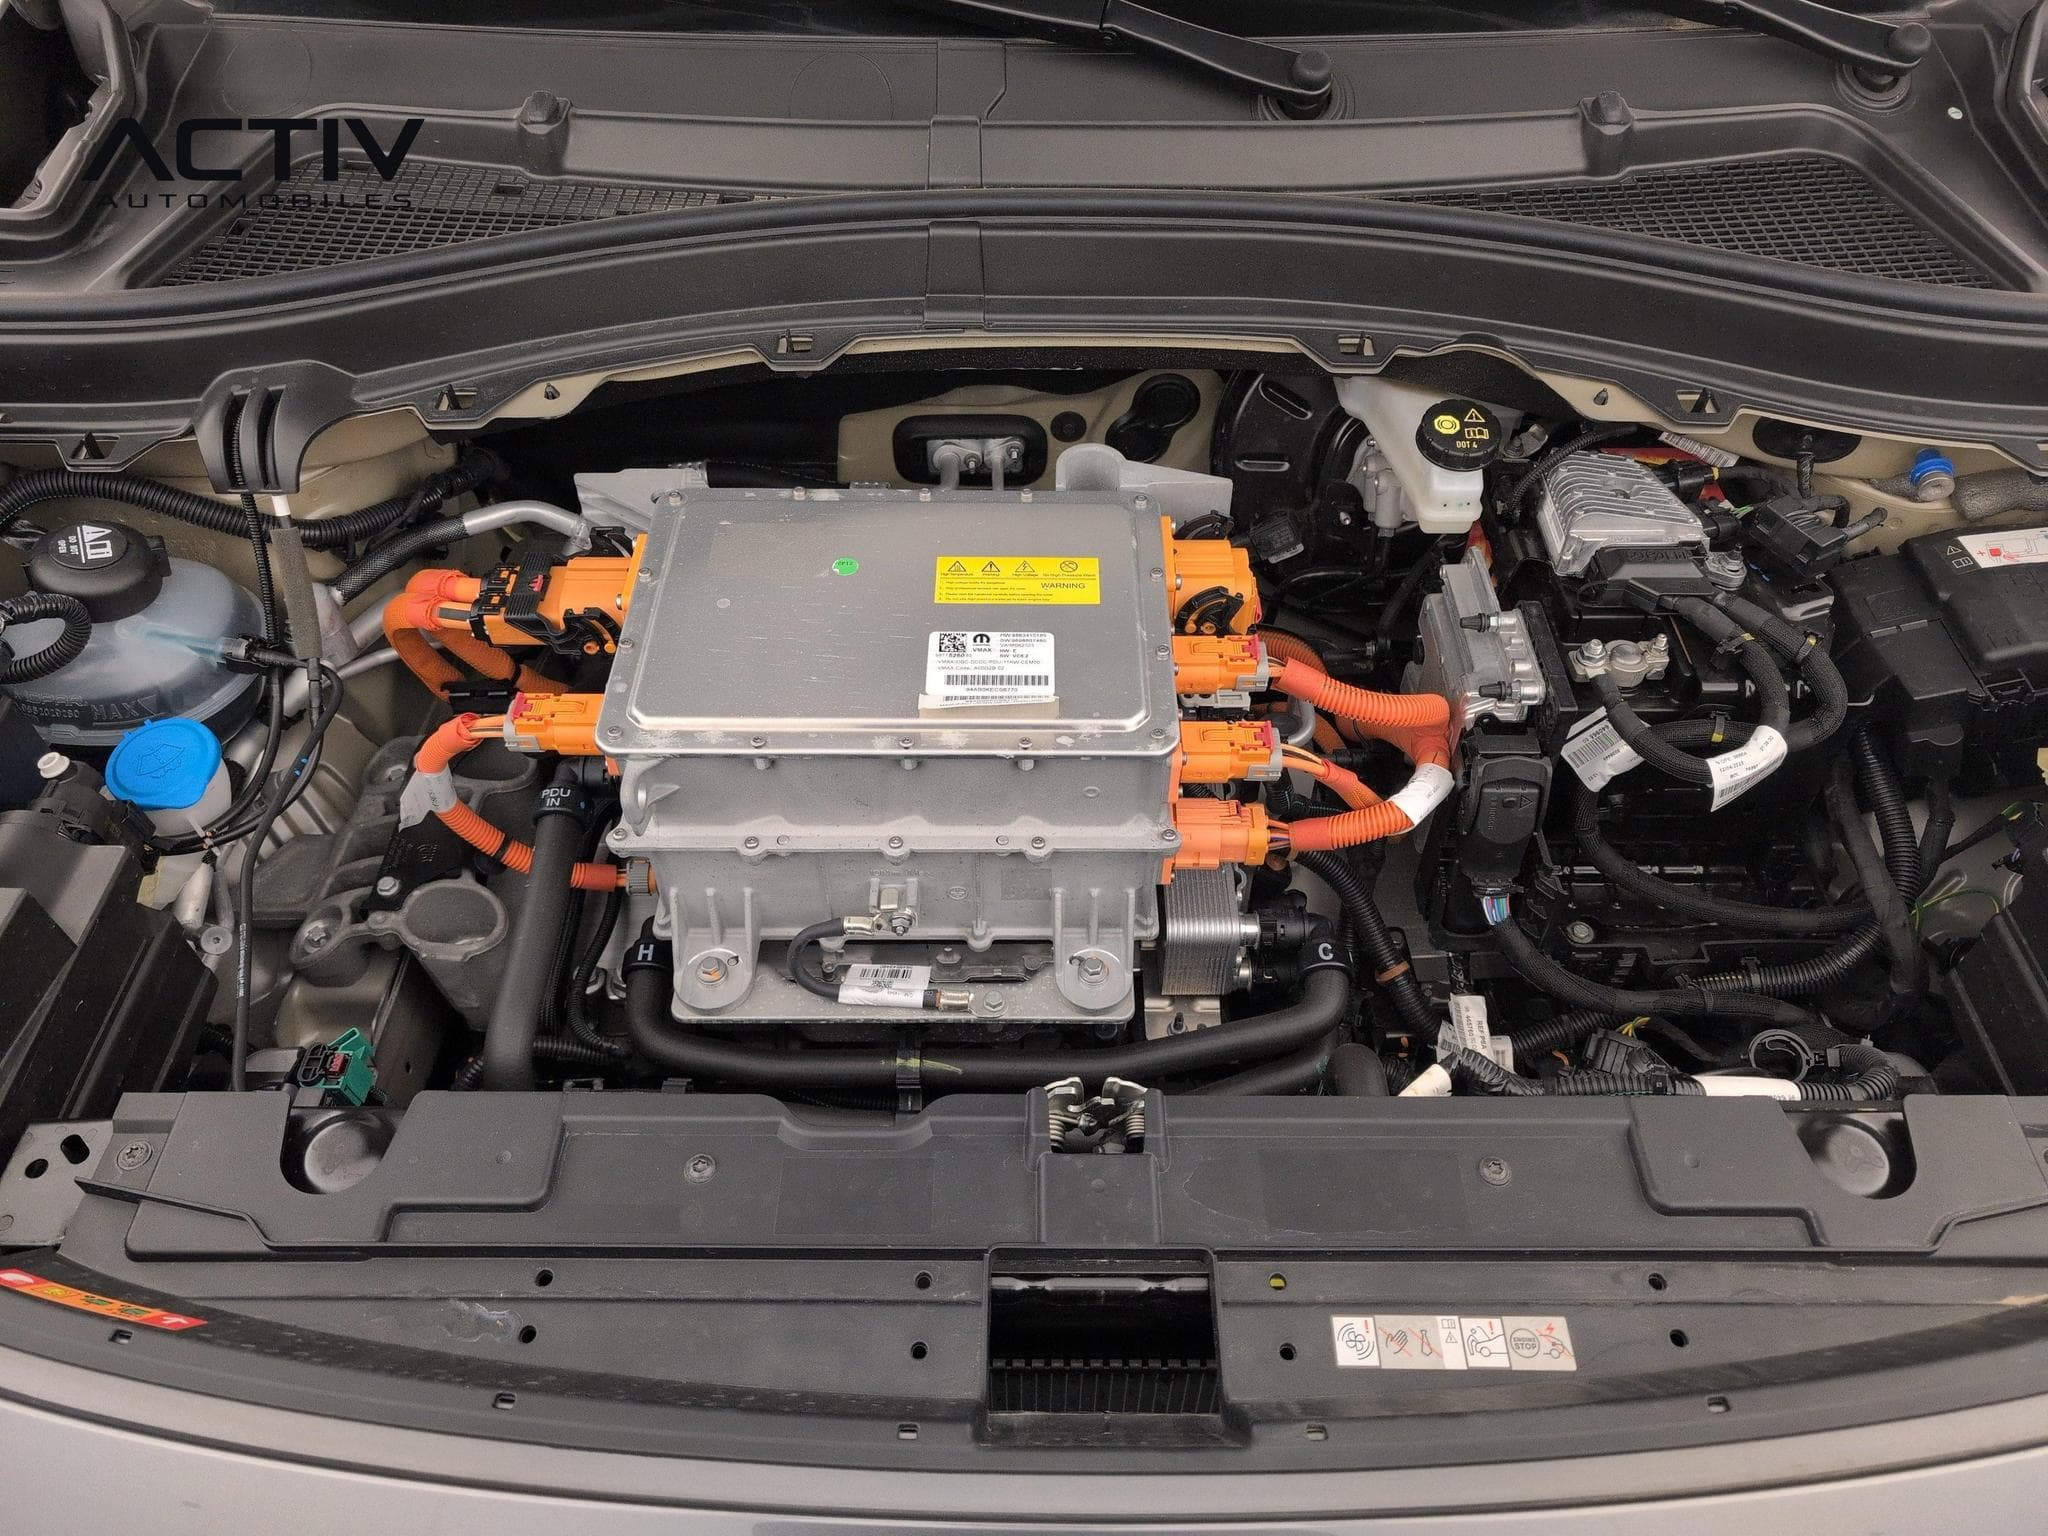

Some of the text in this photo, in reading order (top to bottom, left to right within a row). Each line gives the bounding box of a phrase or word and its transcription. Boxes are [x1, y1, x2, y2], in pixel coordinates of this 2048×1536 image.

[1456, 440, 1478, 449] DOT 4
[1041, 582, 1086, 590] WARNING
[541, 787, 571, 799] PDU
[546, 797, 560, 807] IN
[637, 944, 654, 961] H
